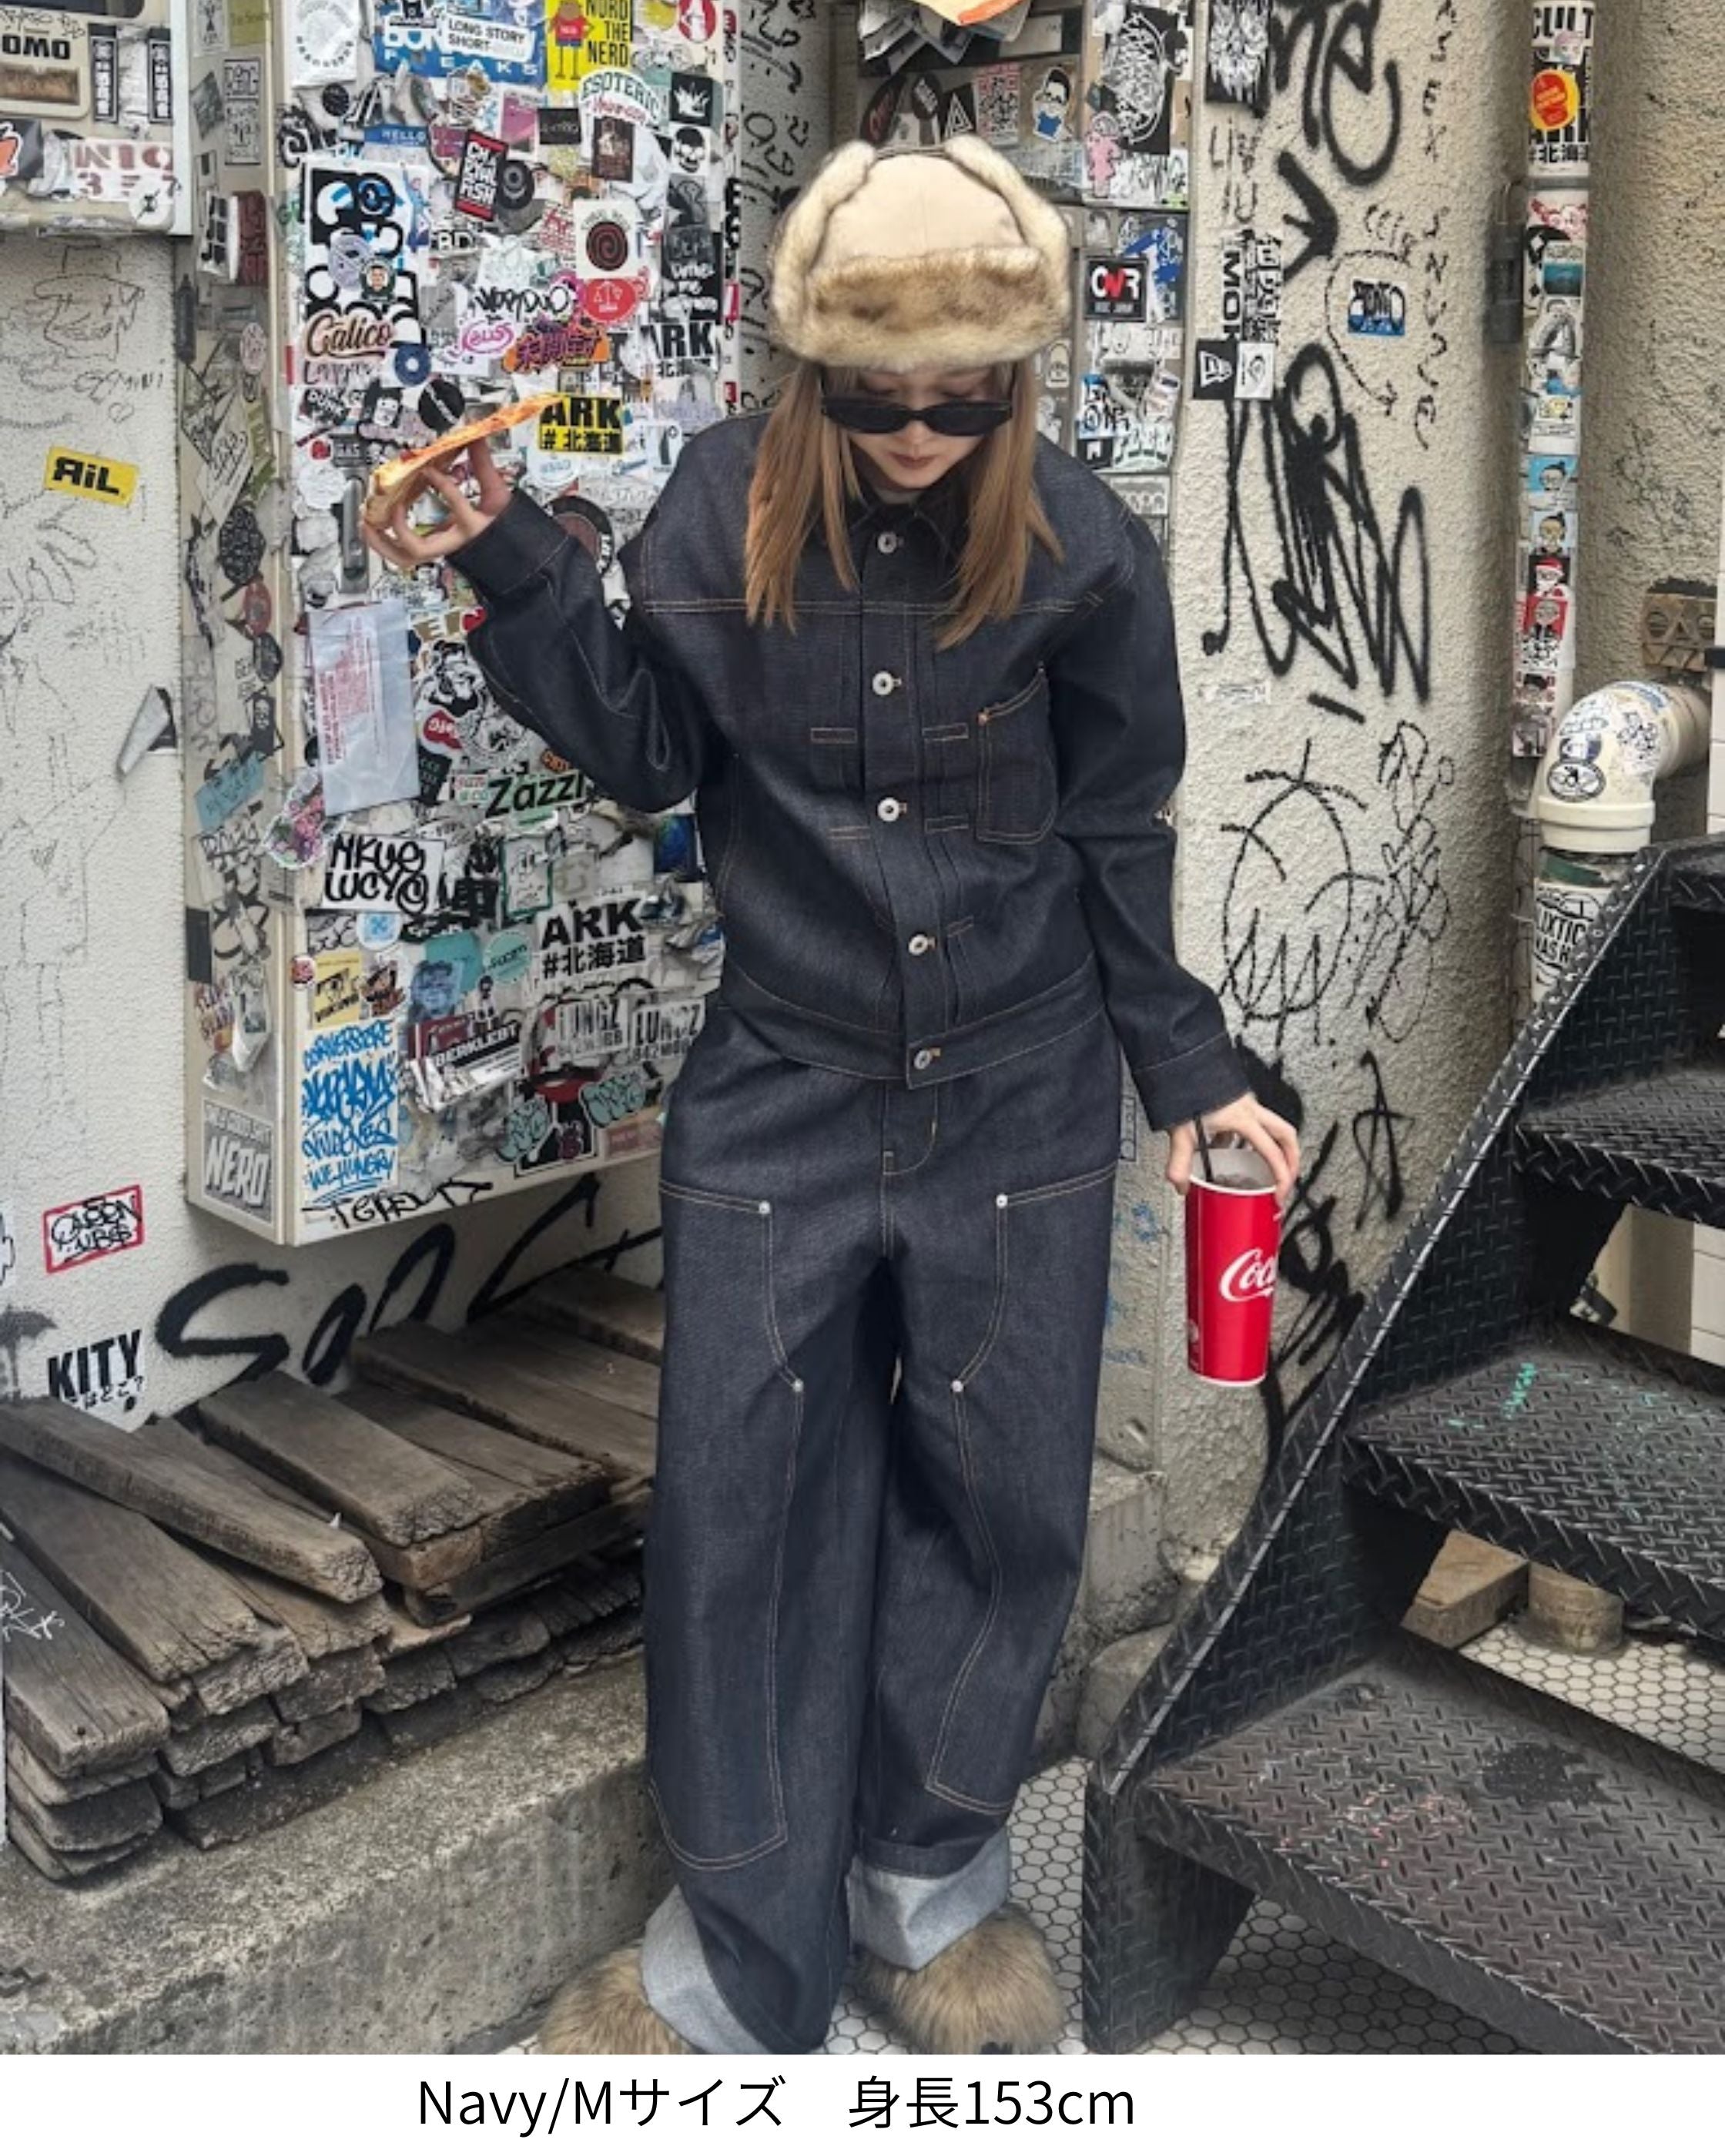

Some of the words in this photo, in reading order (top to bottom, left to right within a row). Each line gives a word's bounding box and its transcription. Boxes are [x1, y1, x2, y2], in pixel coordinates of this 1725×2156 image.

[447, 19, 484, 37] LONG
[604, 21, 629, 42] THE
[588, 40, 629, 68] NERD
[306, 313, 394, 359] Calico
[540, 397, 621, 428] ARK
[542, 898, 644, 949] ARK
[542, 934, 645, 979] #北海道
[206, 1136, 272, 1208] NERD
[47, 1328, 142, 1403] KITY
